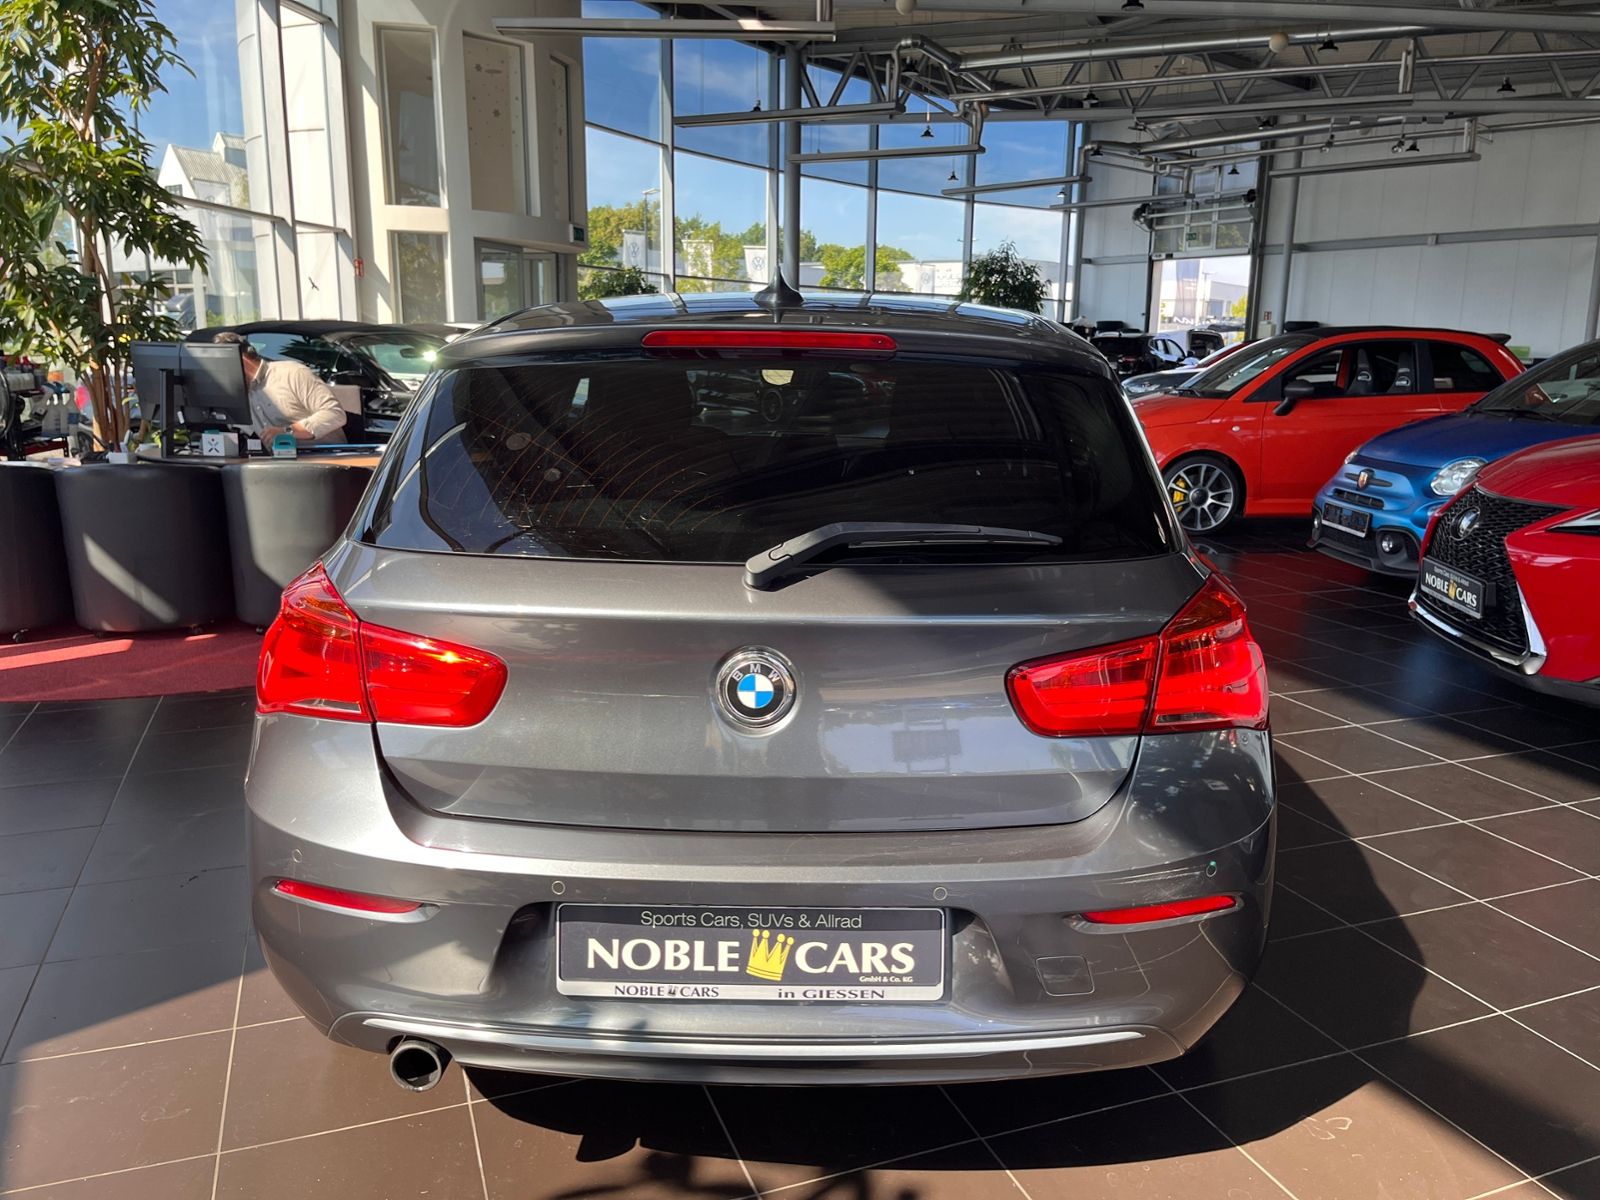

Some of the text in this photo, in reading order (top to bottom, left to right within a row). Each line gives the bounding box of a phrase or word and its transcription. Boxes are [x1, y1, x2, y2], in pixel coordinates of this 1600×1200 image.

[1425, 572, 1448, 594] NOBLE
[1456, 587, 1477, 607] CARS
[732, 663, 781, 682] BMW
[640, 910, 862, 930] Sports Cars, SUVs & Allrad
[587, 938, 915, 974] NOBLE CARS
[614, 985, 720, 998] NOBLE CARS
[778, 988, 885, 999] in GIESSEN
